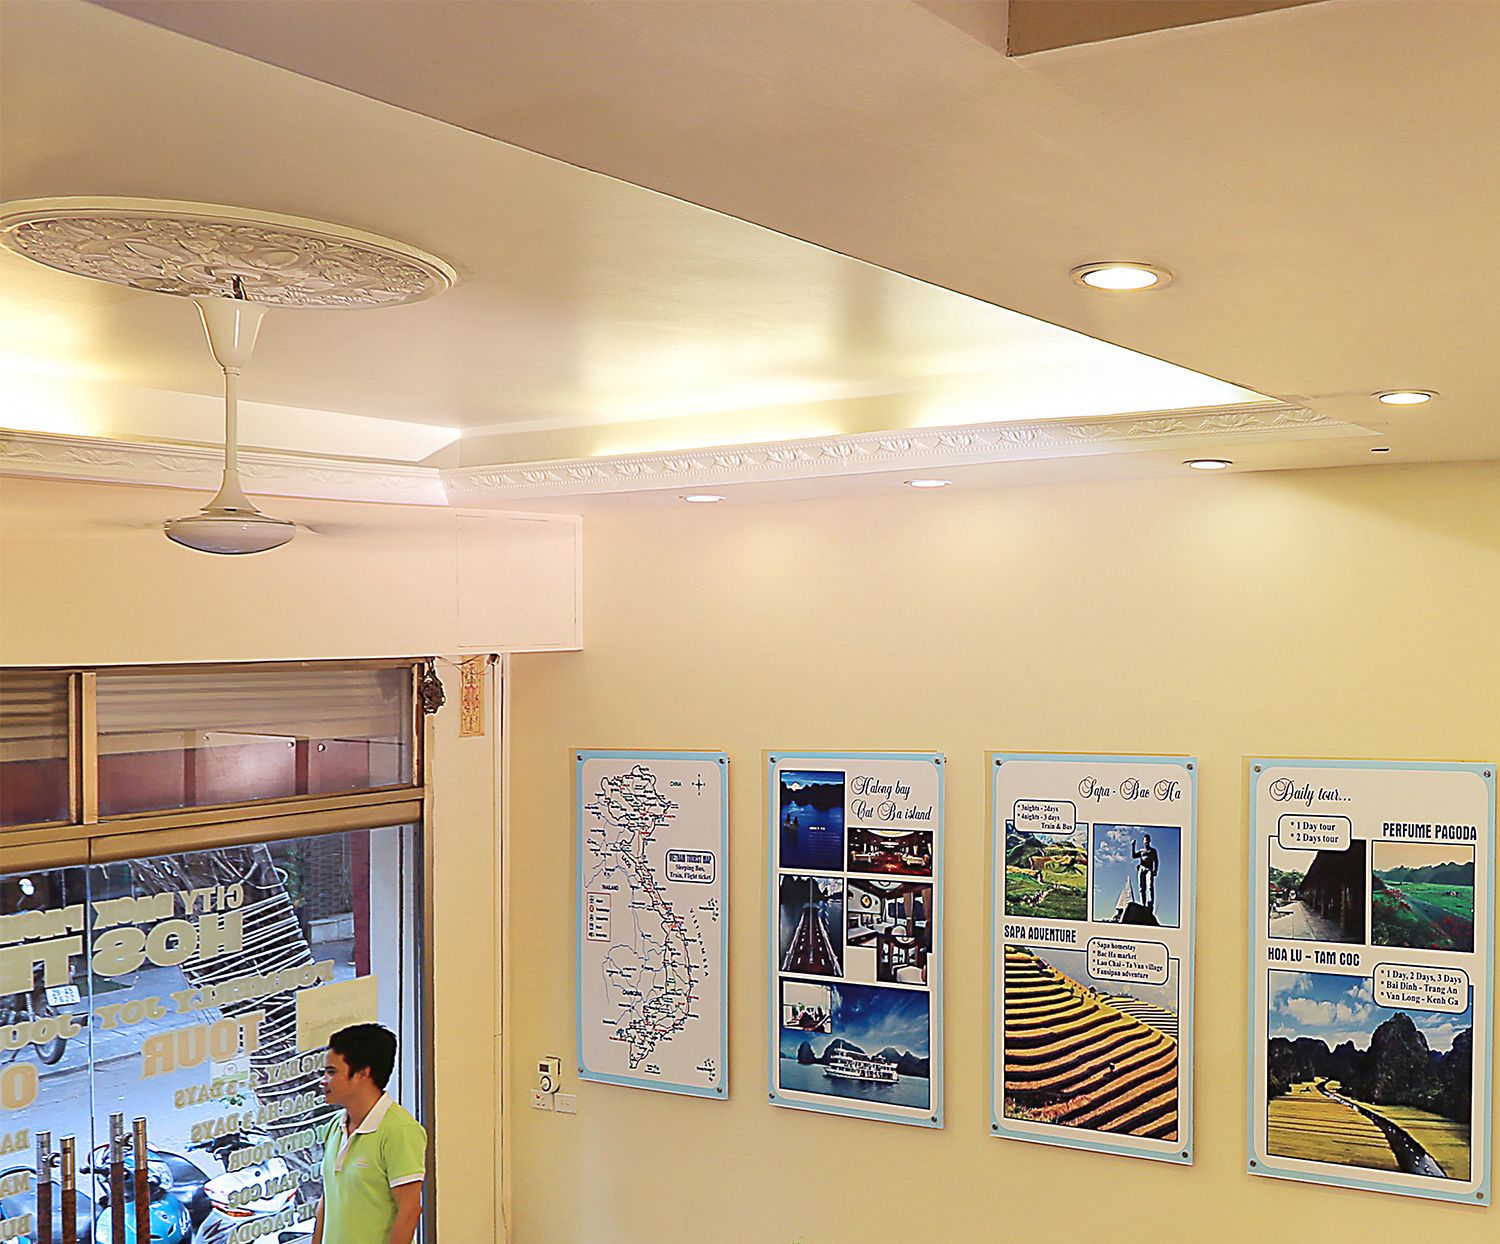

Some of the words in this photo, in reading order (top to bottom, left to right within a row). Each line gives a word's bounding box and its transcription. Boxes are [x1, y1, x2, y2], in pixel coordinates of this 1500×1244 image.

[850, 775, 893, 800] Halong
[894, 779, 911, 801] bay
[1078, 776, 1110, 803] Sapa
[1153, 779, 1182, 803] Ha
[1269, 777, 1315, 807] Daily
[877, 800, 903, 821] Ba
[904, 805, 933, 821] island
[1302, 821, 1318, 832] Day
[1319, 823, 1336, 831] tour
[1382, 822, 1432, 840] PERFUME
[1434, 824, 1478, 841] PAGODA
[1302, 833, 1322, 844] Days
[1322, 835, 1339, 843] tour
[1004, 924, 1026, 940] SAPA
[1027, 926, 1077, 944] ADVENTURE
[1267, 947, 1288, 962] HOA
[1289, 948, 1303, 963] LU
[1314, 950, 1337, 966] TAM
[1386, 980, 1399, 990] Bai
[1400, 981, 1418, 991] Dinh
[1424, 984, 1446, 995] Trang
[1446, 986, 1458, 995] An
[1443, 974, 1462, 985] Days
[1386, 991, 1400, 1001] Van
[1401, 993, 1421, 1004] Long
[1447, 996, 1459, 1006] Ga
